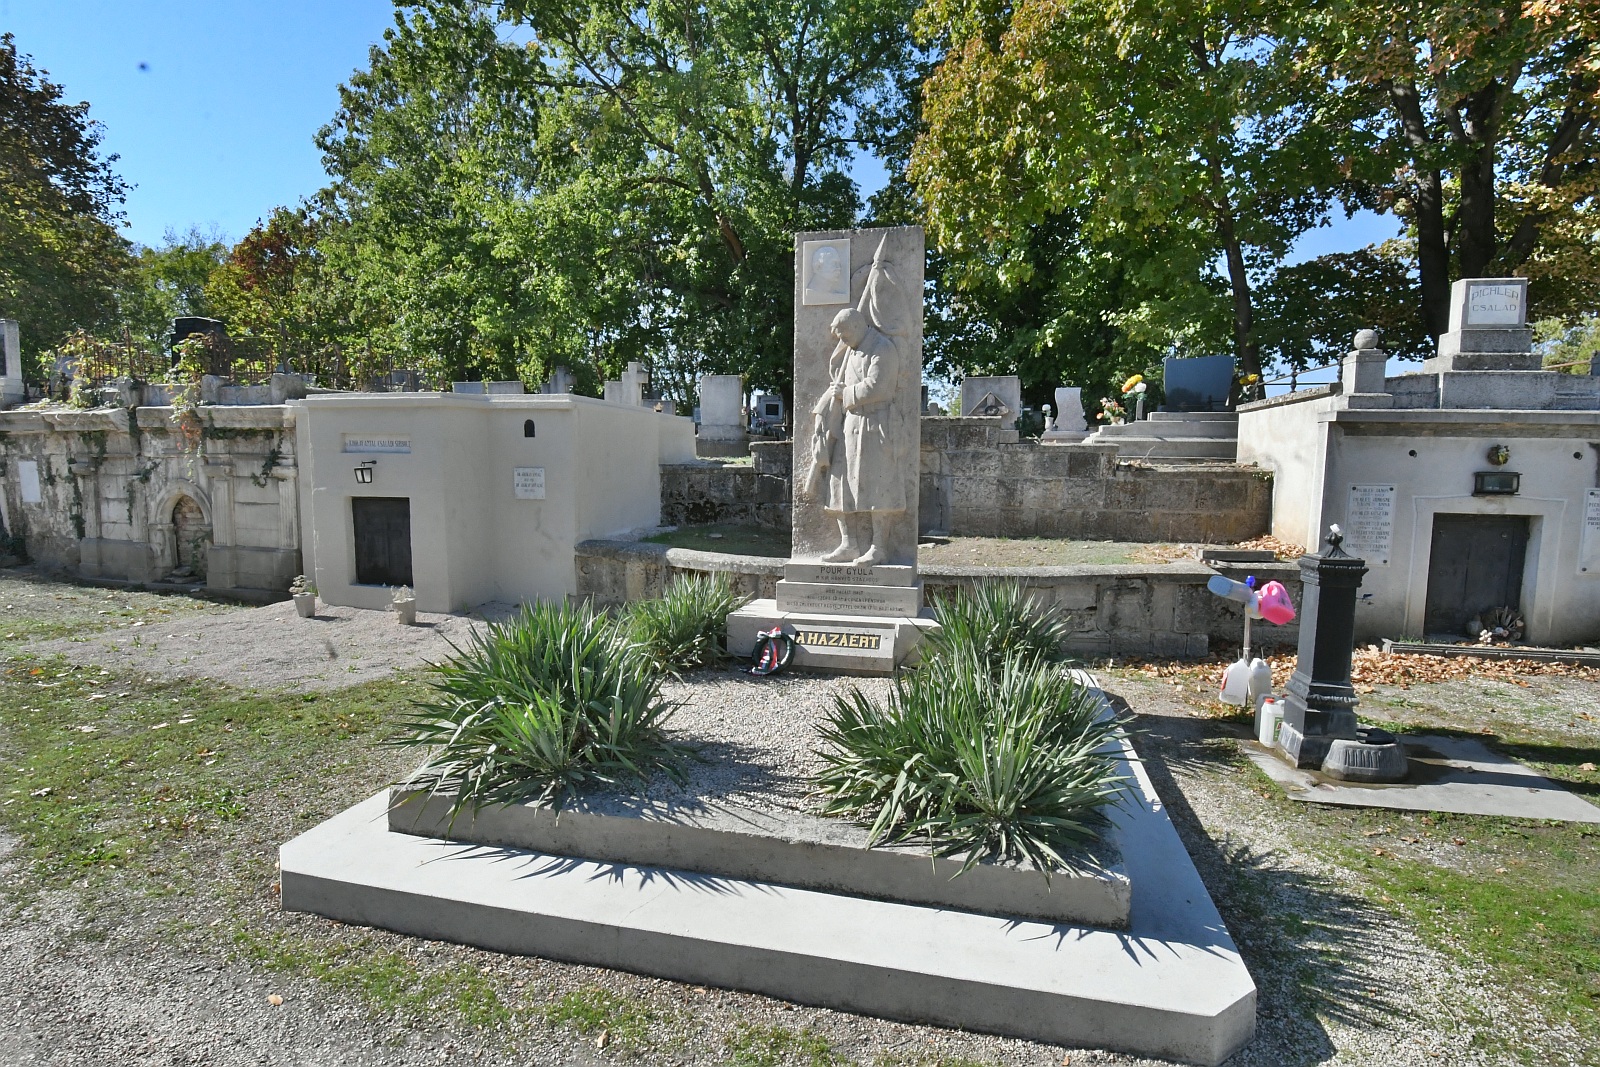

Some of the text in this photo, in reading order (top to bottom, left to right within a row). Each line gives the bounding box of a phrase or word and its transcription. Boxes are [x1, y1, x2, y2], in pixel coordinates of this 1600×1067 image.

[1471, 286, 1519, 301] PICHLER
[820, 566, 874, 576] POUR GYULA
